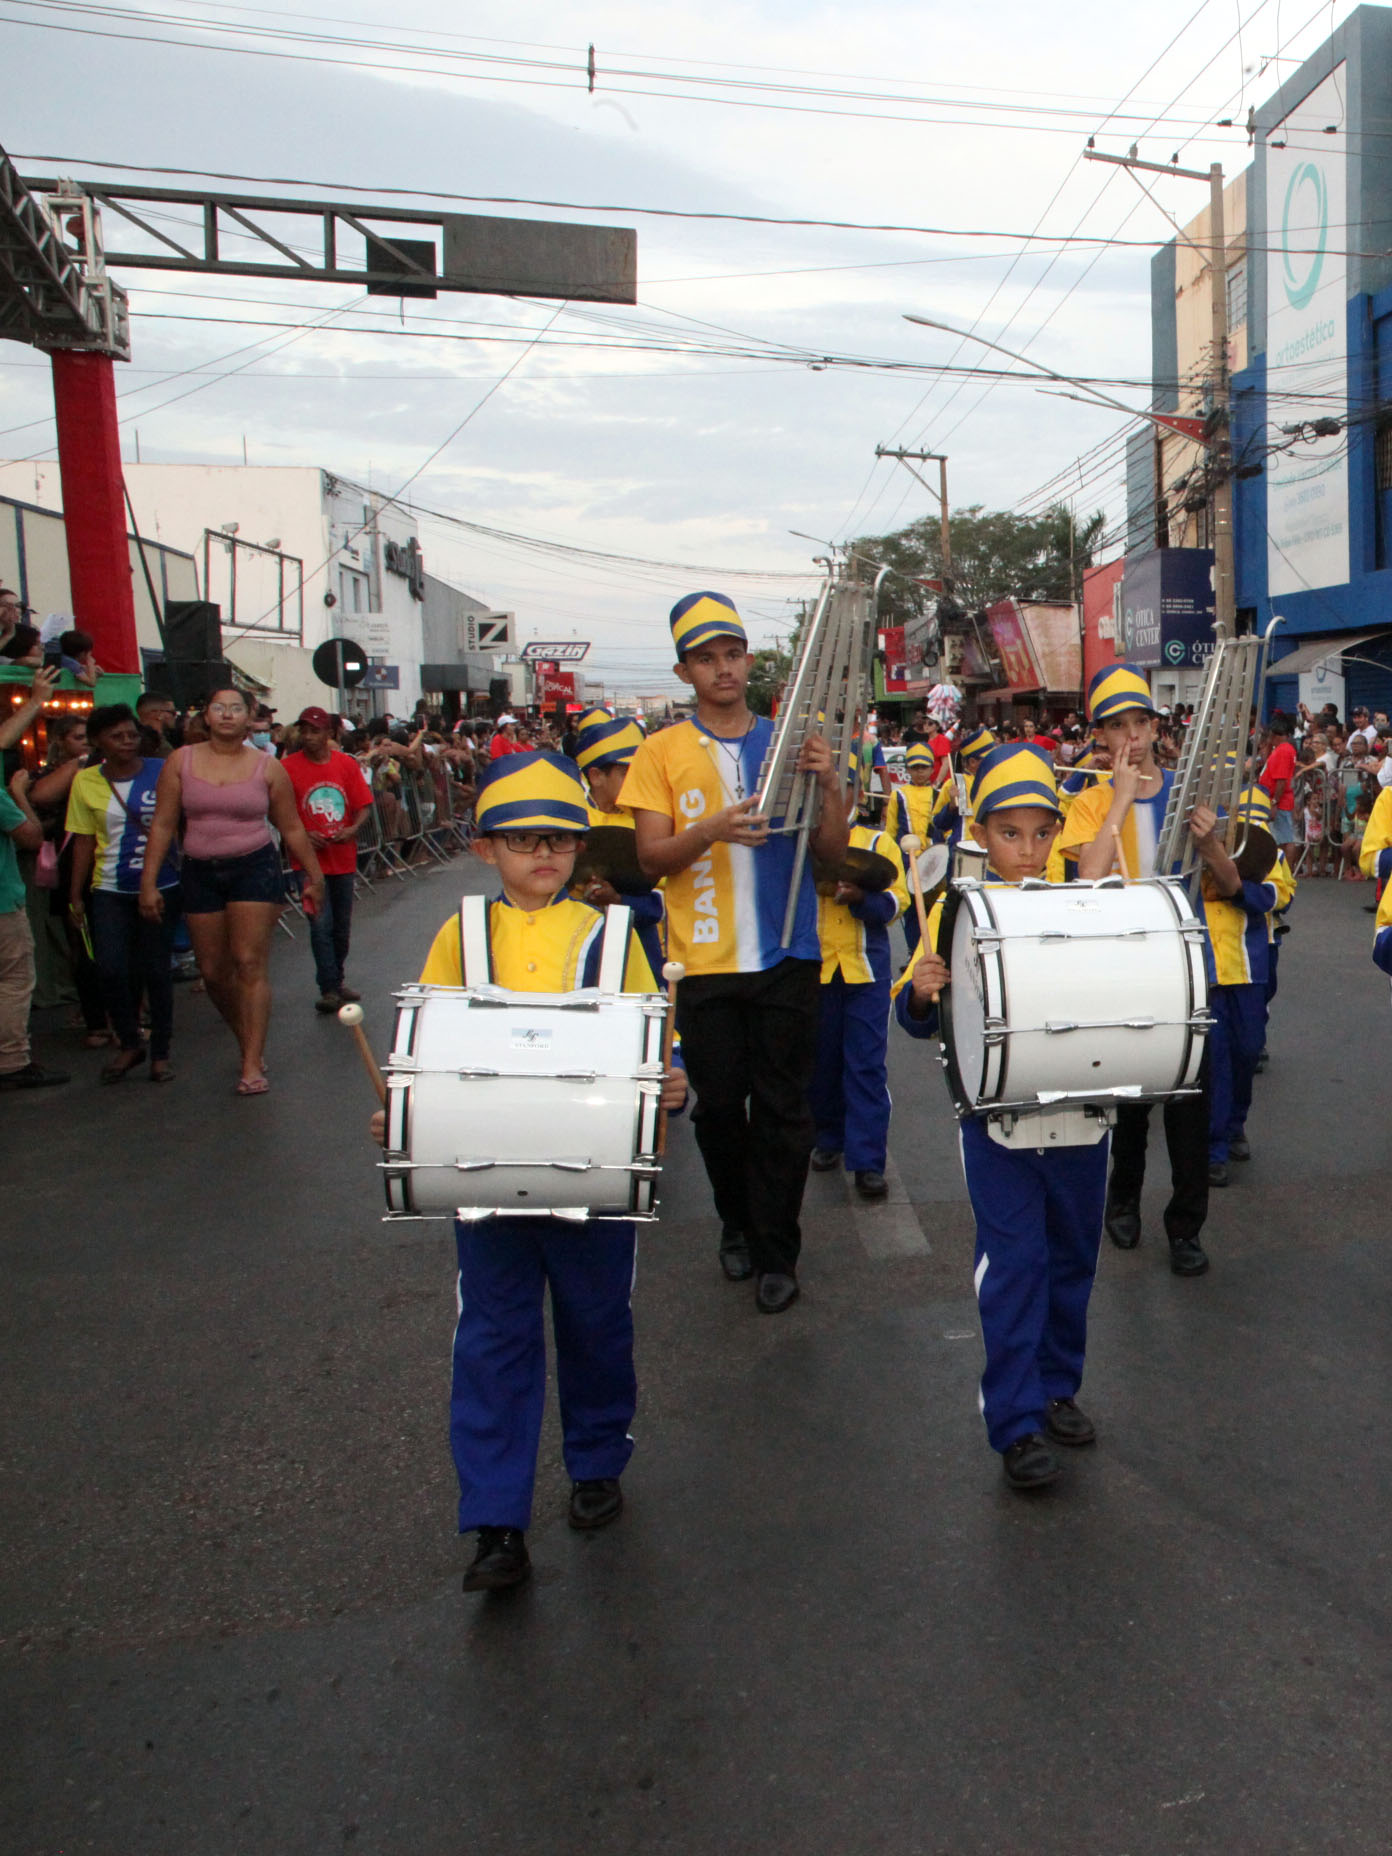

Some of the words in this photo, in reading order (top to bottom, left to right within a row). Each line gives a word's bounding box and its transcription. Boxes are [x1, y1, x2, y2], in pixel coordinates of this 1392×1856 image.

[1135, 604, 1155, 628] ÓTICA
[467, 615, 476, 651] STUDIO
[1136, 627, 1161, 648] CENTER
